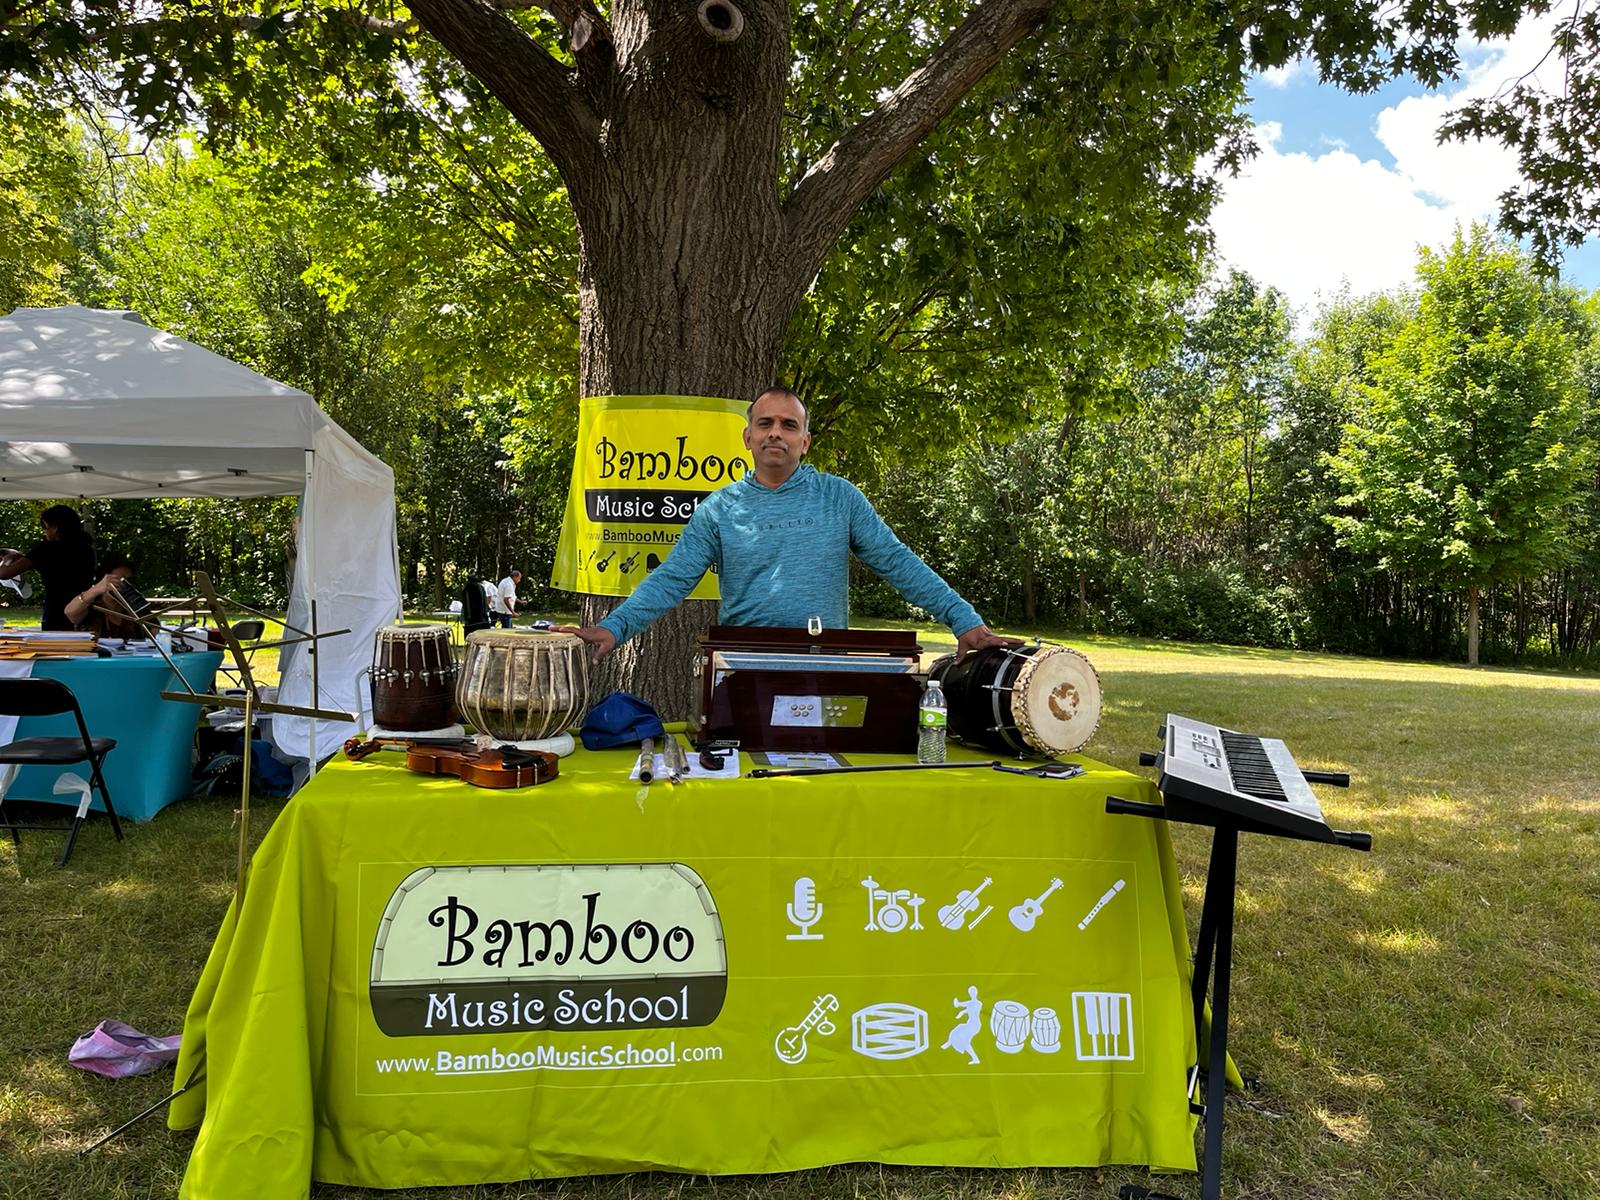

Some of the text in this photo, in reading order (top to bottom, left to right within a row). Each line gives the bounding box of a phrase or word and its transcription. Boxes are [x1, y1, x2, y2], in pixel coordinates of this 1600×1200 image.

[596, 436, 749, 483] Bamboo
[596, 495, 655, 518] Music
[427, 892, 695, 969] Bamboo
[424, 985, 690, 1029] Music School
[376, 1042, 724, 1074] www.BambooMusicSchool.com
